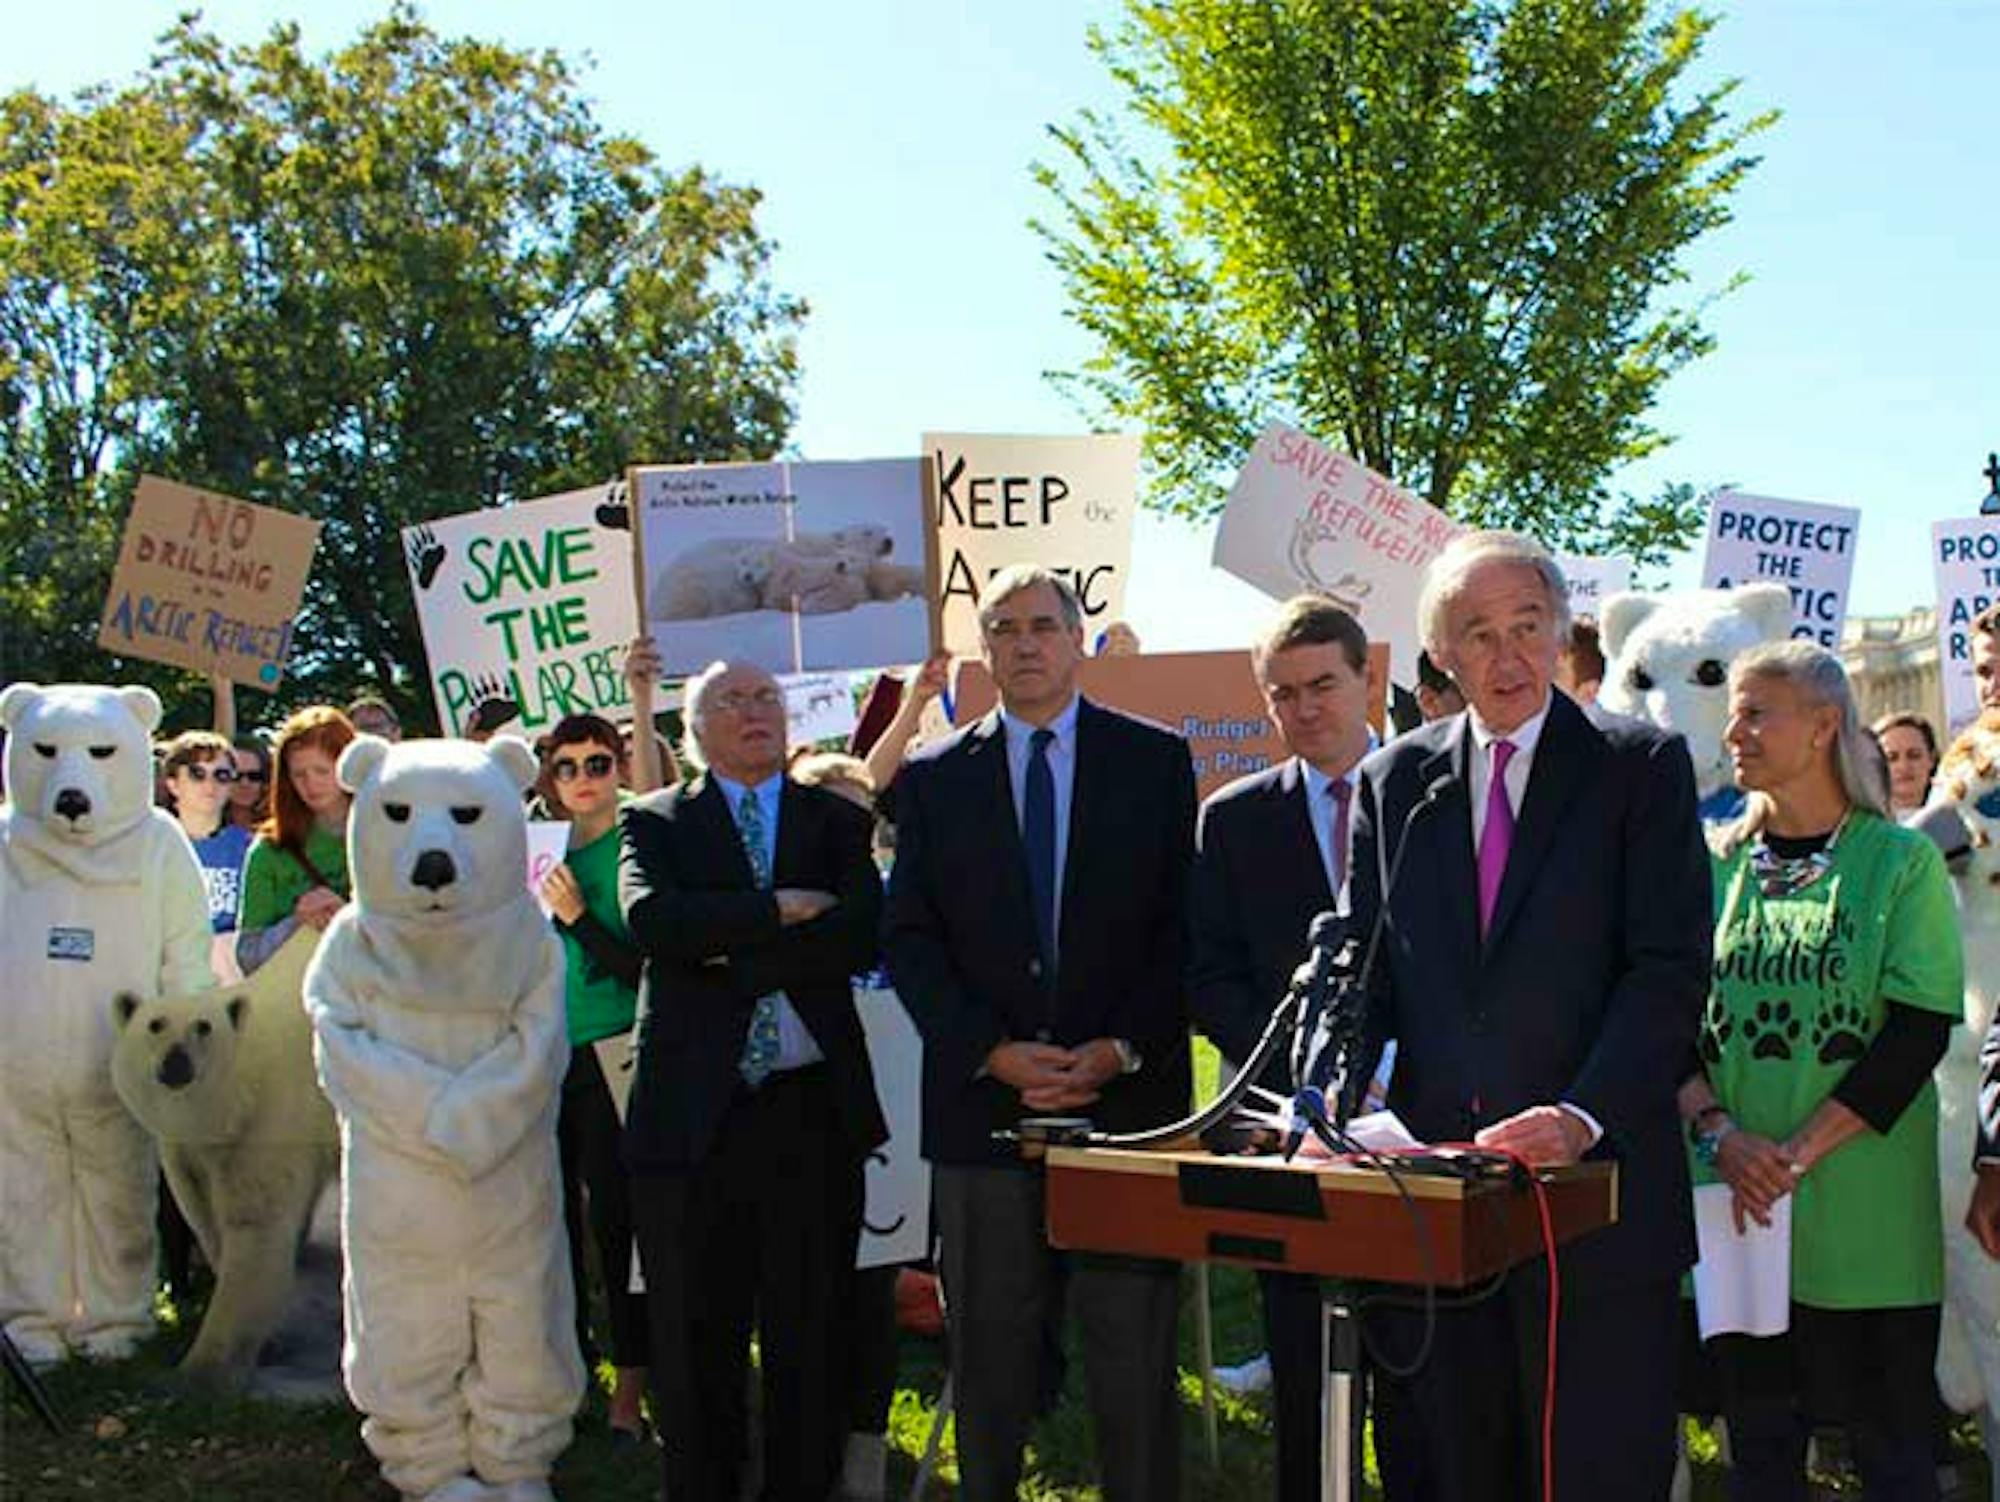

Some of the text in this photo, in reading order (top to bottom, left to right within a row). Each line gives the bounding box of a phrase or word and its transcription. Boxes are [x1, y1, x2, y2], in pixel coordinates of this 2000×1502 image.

[937, 449, 1069, 529] KEEP
[1271, 430, 1348, 487] SAVE
[1364, 475, 1408, 526] THE
[189, 498, 255, 549] NO
[1717, 511, 1852, 553] PROTECT
[136, 535, 272, 591] DRILLING
[463, 528, 598, 603] SAVE
[942, 549, 1114, 615] AIC
[1757, 552, 1803, 578] THE
[486, 598, 590, 661] THE
